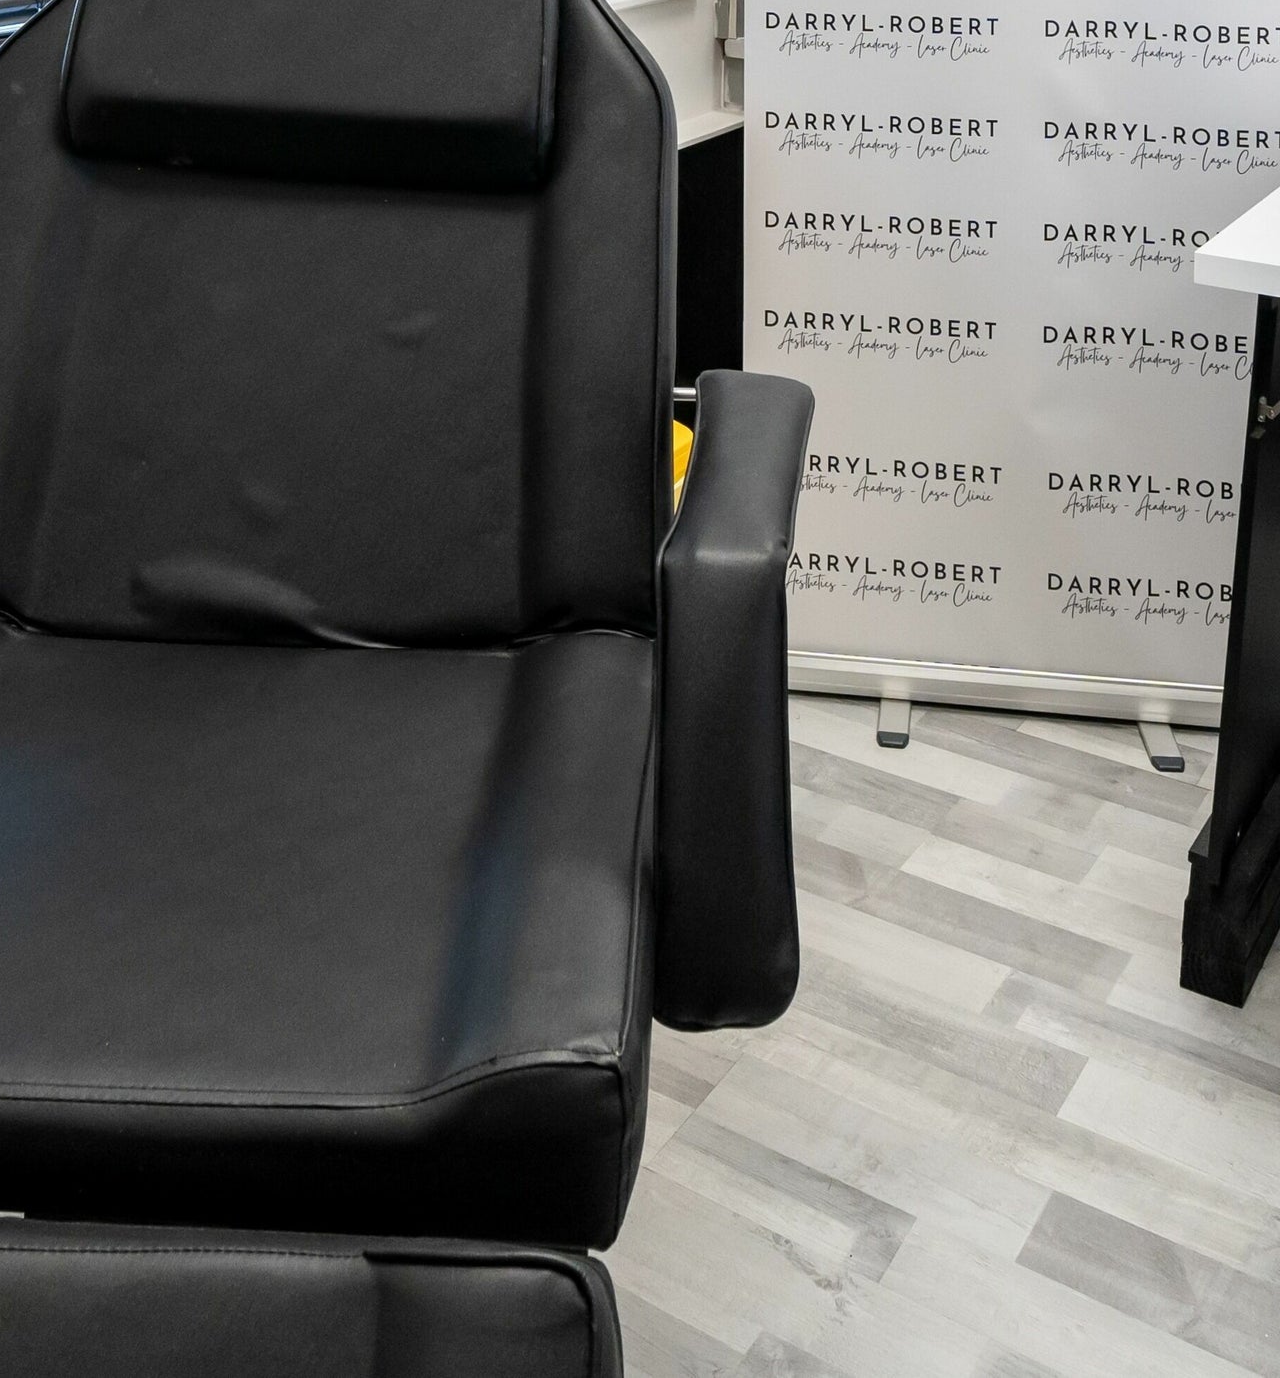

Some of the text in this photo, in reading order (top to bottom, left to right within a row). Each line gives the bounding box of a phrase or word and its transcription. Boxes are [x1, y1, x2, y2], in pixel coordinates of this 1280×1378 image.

[766, 12, 999, 36] DARRYL-ROBERT
[779, 33, 990, 61] Aesthetics Academy Laser Clinic
[1059, 42, 1279, 71] Aesthetics Academy Laser Clinic
[766, 111, 998, 137] DARRYL-ROBERT
[778, 132, 989, 162] Aesthetics Academy Laser Clinic
[1058, 143, 1278, 174] Aesthetics Academy Laser Clinic
[765, 211, 997, 238] DARRYL-ROBERT
[1044, 224, 1219, 248] DARRYL-RO
[778, 231, 989, 263] Aesthetics Academy Laser Clinic
[1058, 246, 1184, 272] Aesthetics Academy
[765, 310, 996, 338] DARRYL-ROBERT
[777, 331, 988, 363] Aesthetics Academy Laser Clinic
[1057, 348, 1113, 370] Aesthetics
[1129, 352, 1183, 374] Academy
[1200, 355, 1231, 377] Laser
[853, 479, 905, 502] Academy
[921, 482, 950, 504] Laser
[954, 483, 993, 507] Clinic
[1063, 495, 1236, 524] Aesthetics Academy Laser
[785, 569, 992, 607] Aesthetics Academy Laser Clinic
[1062, 595, 1118, 619] Aesthetics
[1135, 600, 1188, 625] Academy
